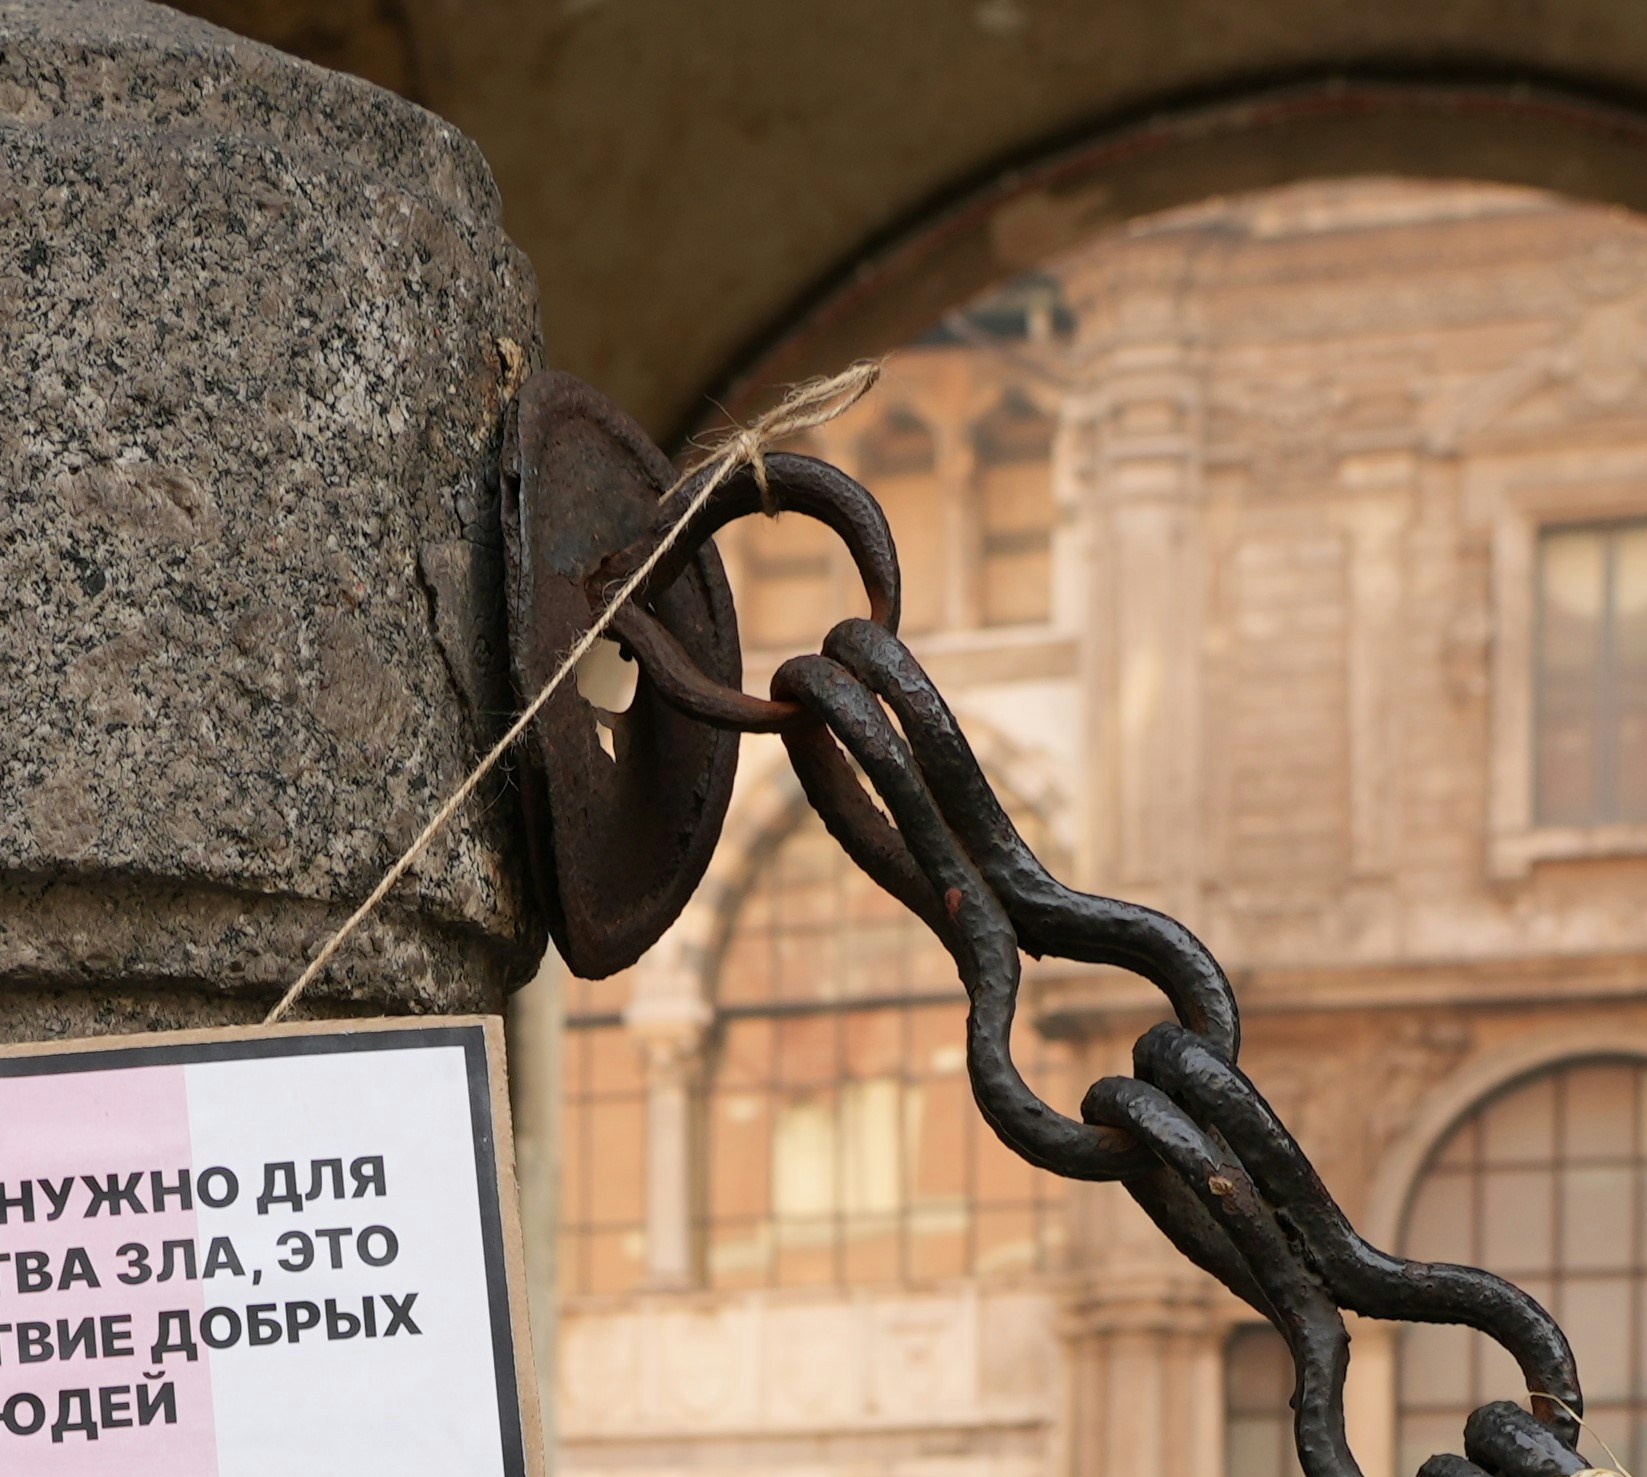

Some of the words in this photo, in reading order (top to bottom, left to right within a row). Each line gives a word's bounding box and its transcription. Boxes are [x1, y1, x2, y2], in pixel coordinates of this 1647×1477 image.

[257, 1156, 386, 1214] ДЛЯ
[117, 1237, 261, 1285] ЗЛА,
[277, 1226, 398, 1271] ЭТО
[151, 1294, 421, 1363] ДОБРЫХ
